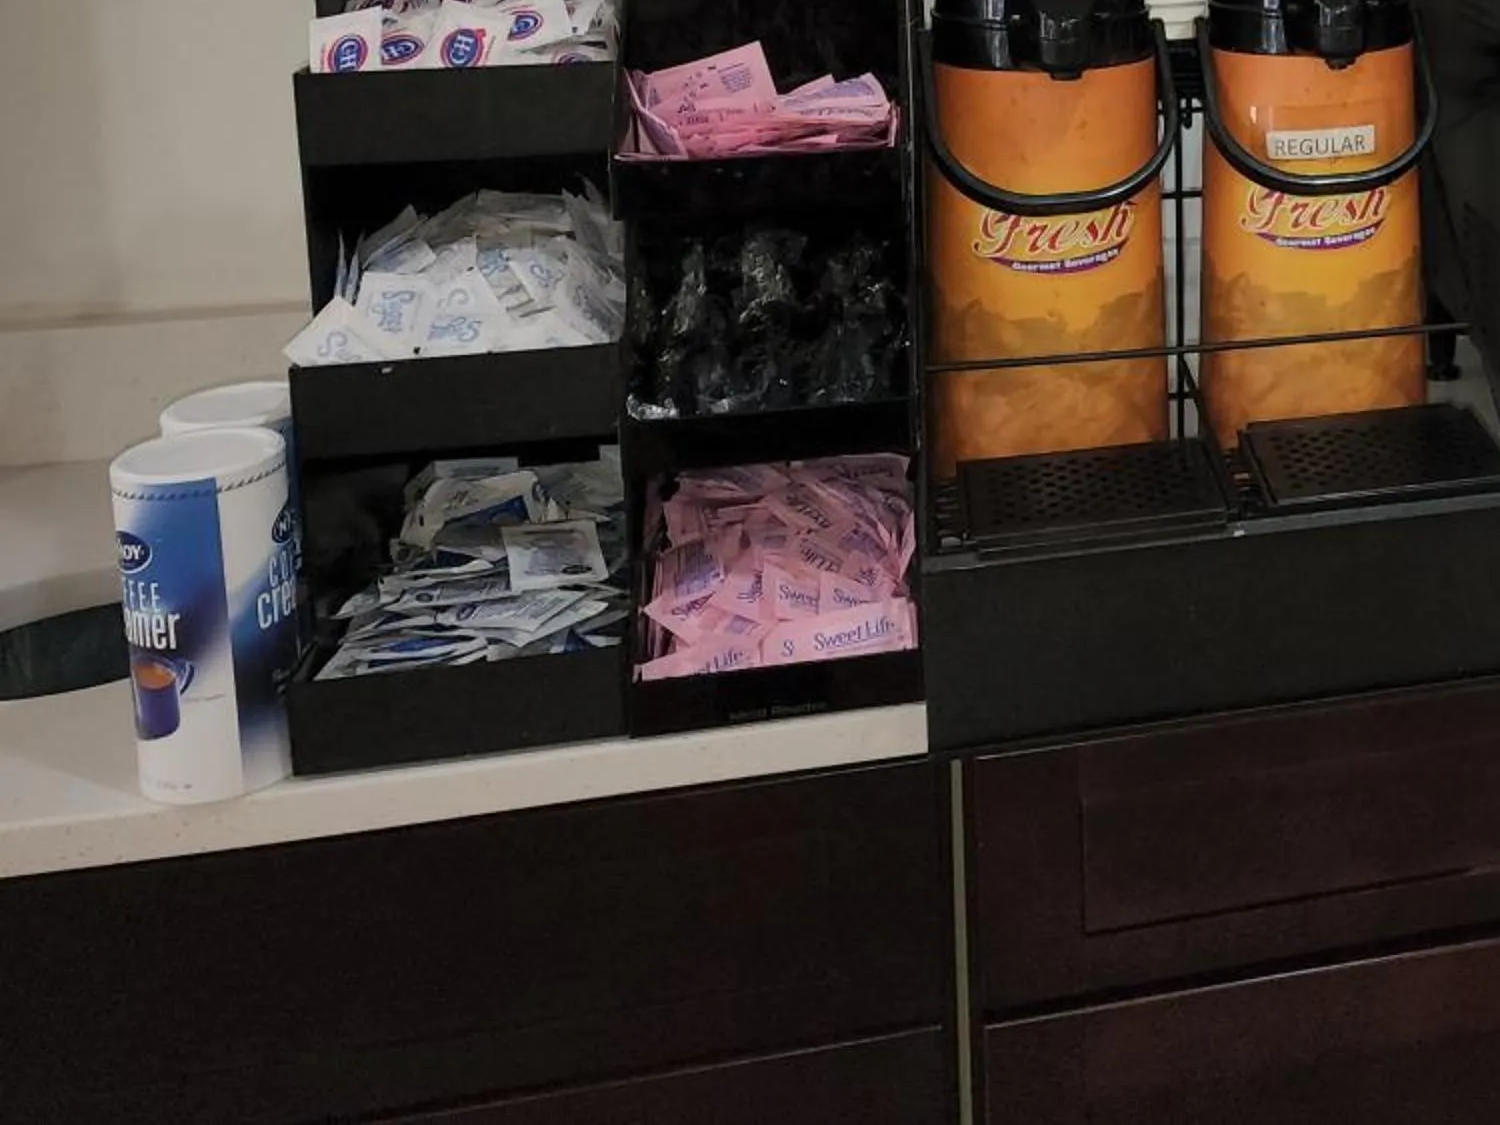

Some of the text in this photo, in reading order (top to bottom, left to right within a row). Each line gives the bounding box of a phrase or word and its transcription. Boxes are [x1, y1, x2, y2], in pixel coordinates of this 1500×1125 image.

[1274, 134, 1366, 156] REGULAR
[1241, 186, 1388, 233] Fresh
[972, 202, 1134, 257] Fresh
[814, 627, 860, 653] Sweet
